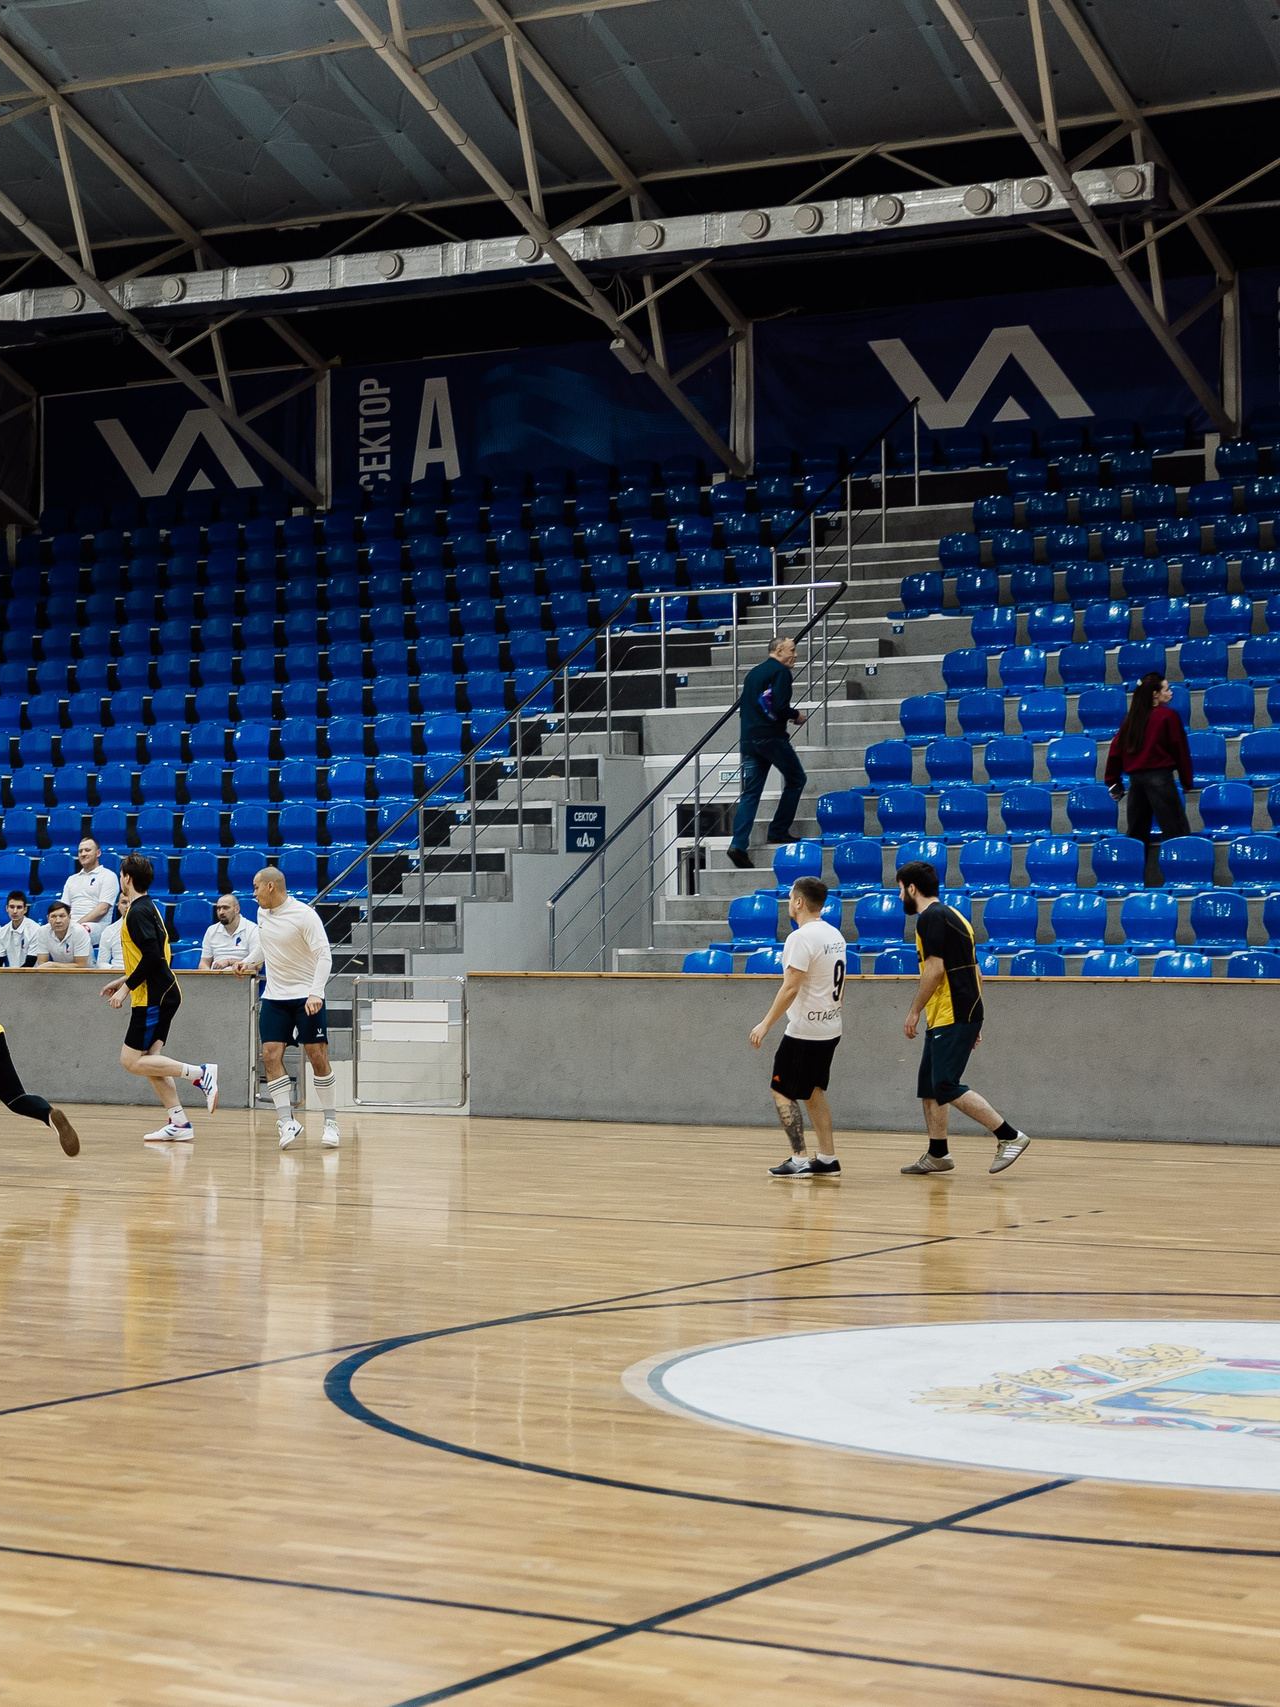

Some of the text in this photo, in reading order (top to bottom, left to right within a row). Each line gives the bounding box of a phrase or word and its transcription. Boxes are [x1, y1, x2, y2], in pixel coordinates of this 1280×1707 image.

[868, 667, 875, 675] 8
[573, 811, 598, 822] СЕКТОР
[832, 959, 845, 1002] 9
